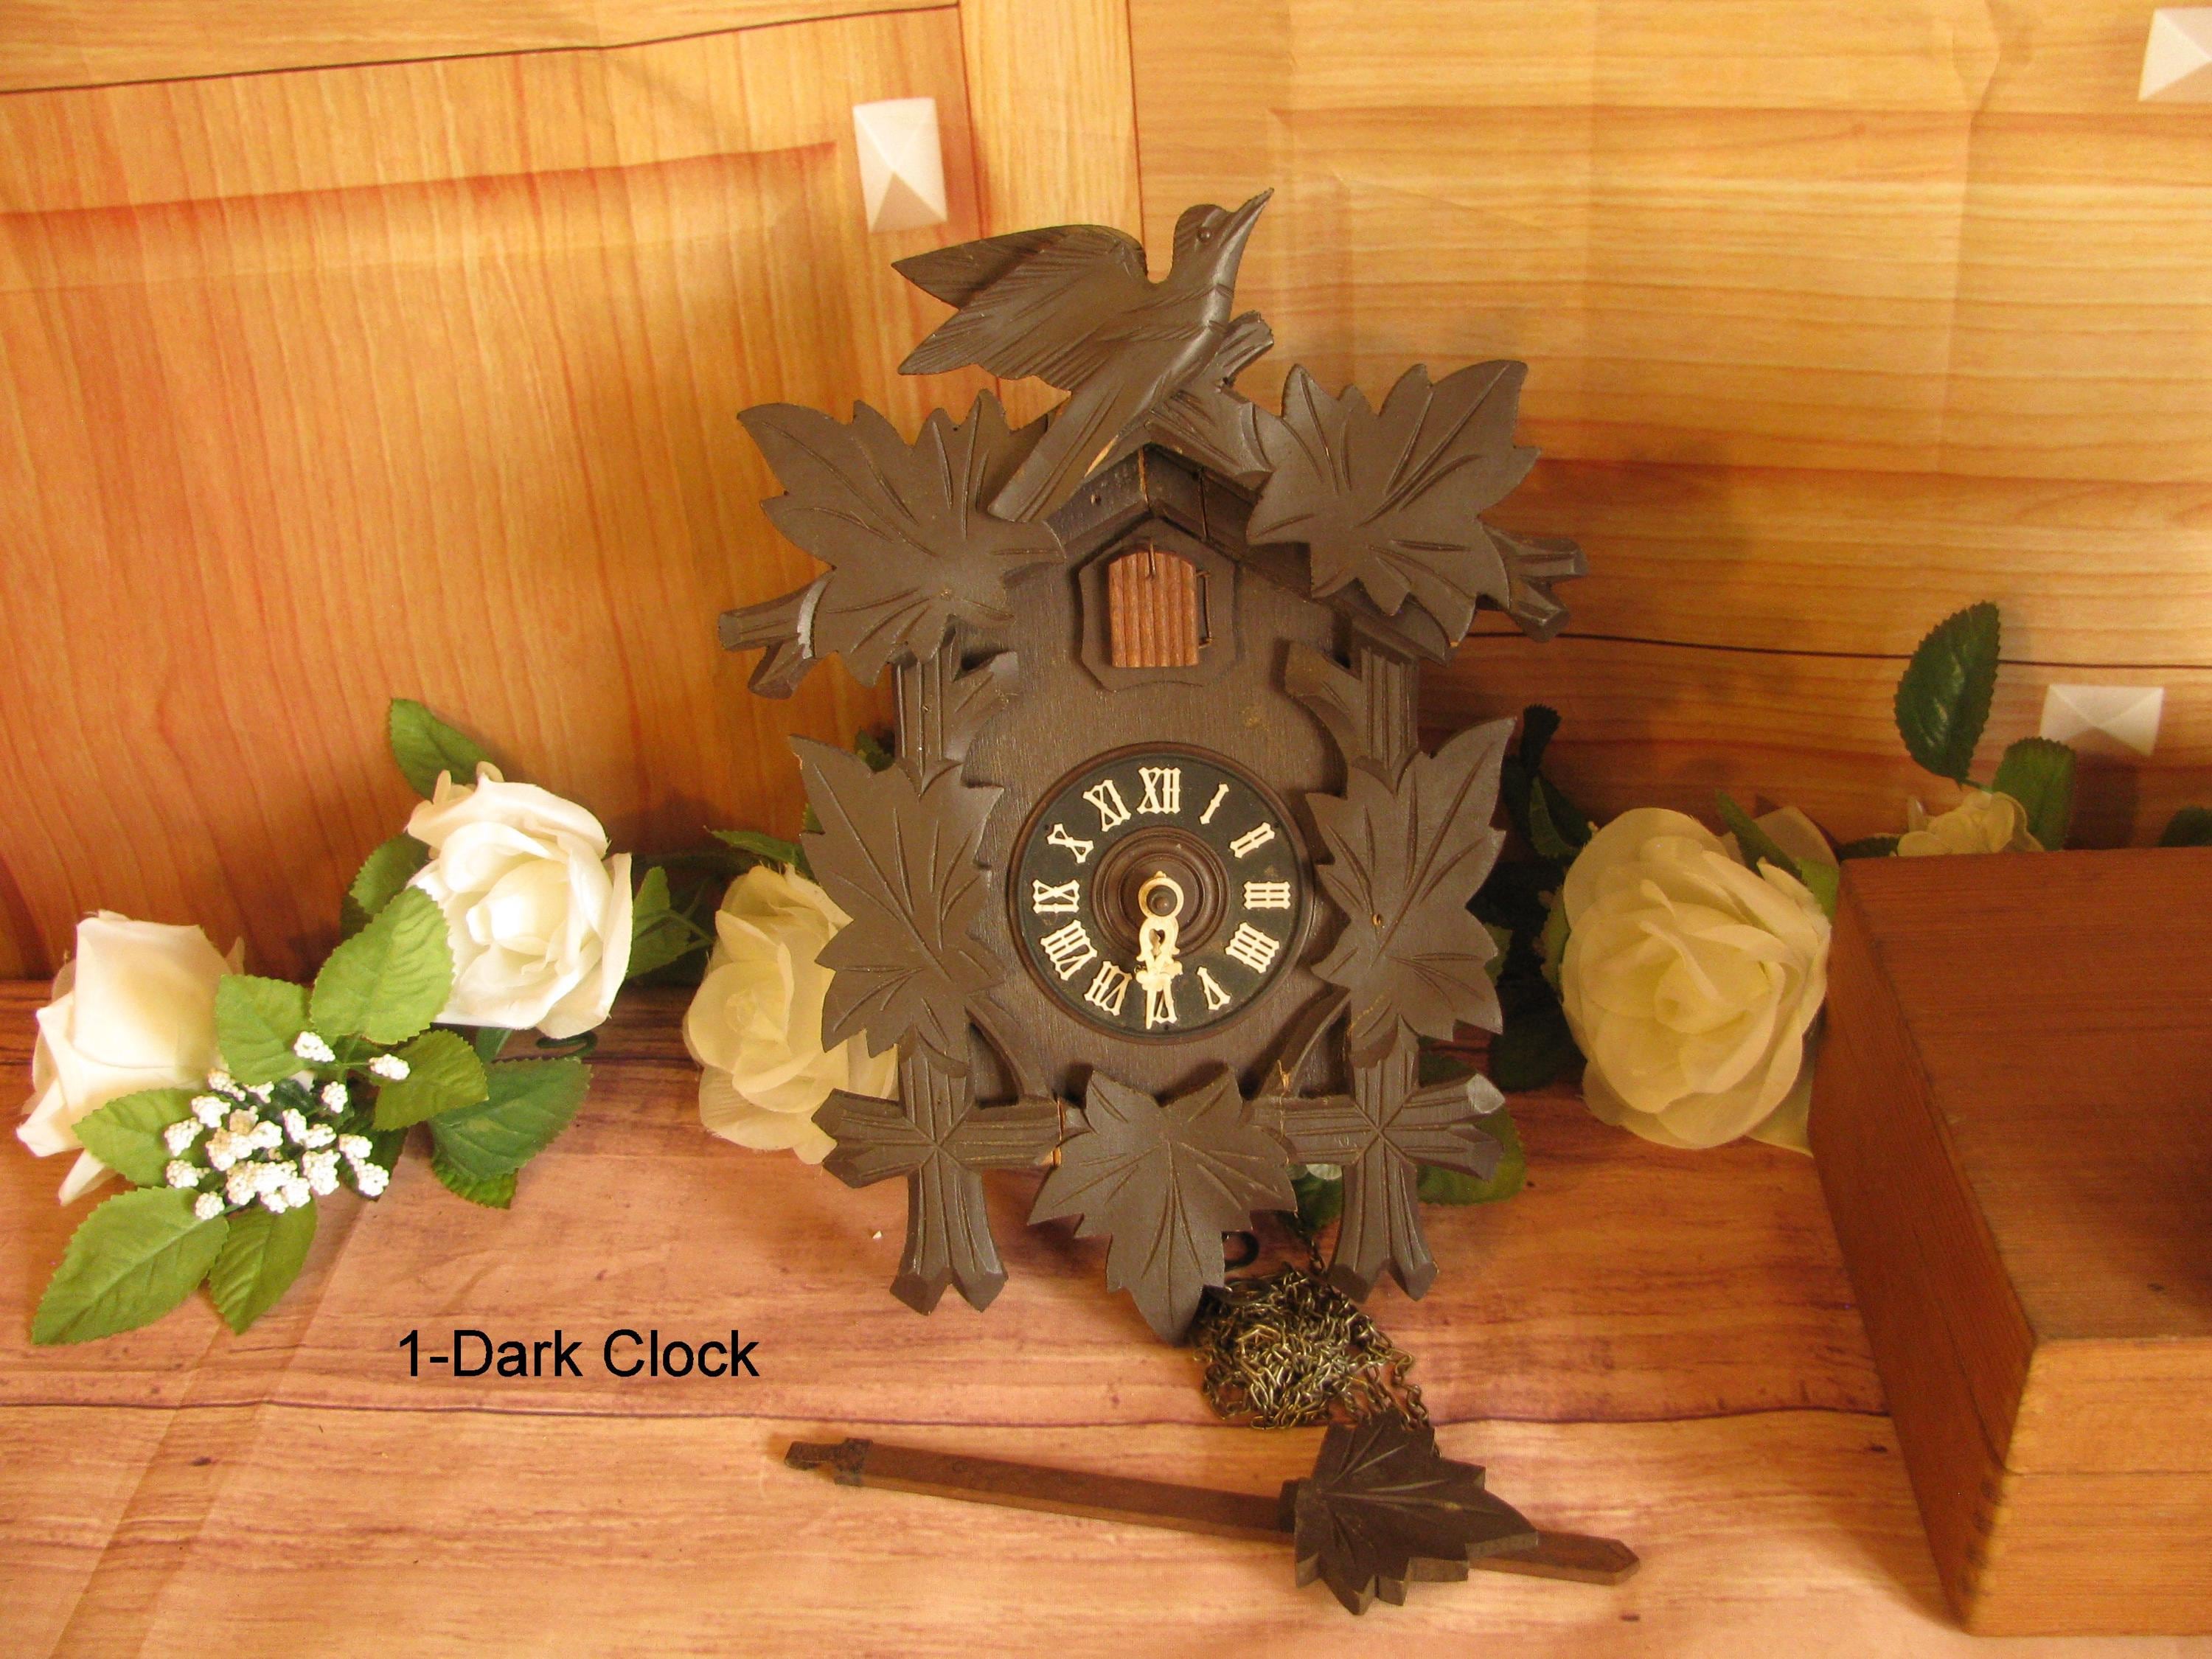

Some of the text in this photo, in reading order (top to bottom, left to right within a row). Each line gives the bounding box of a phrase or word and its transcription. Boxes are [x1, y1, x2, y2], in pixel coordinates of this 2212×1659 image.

[1083, 779, 1131, 832] XI
[1137, 767, 1180, 814] XII
[1047, 823, 1093, 863] X
[1230, 822, 1275, 858] II
[1033, 880, 1079, 914] IX
[1244, 881, 1290, 910] III
[1040, 919, 1097, 981] VIII
[1225, 922, 1279, 973] IIII
[1084, 961, 1133, 1015] VII
[1197, 967, 1231, 1010] V
